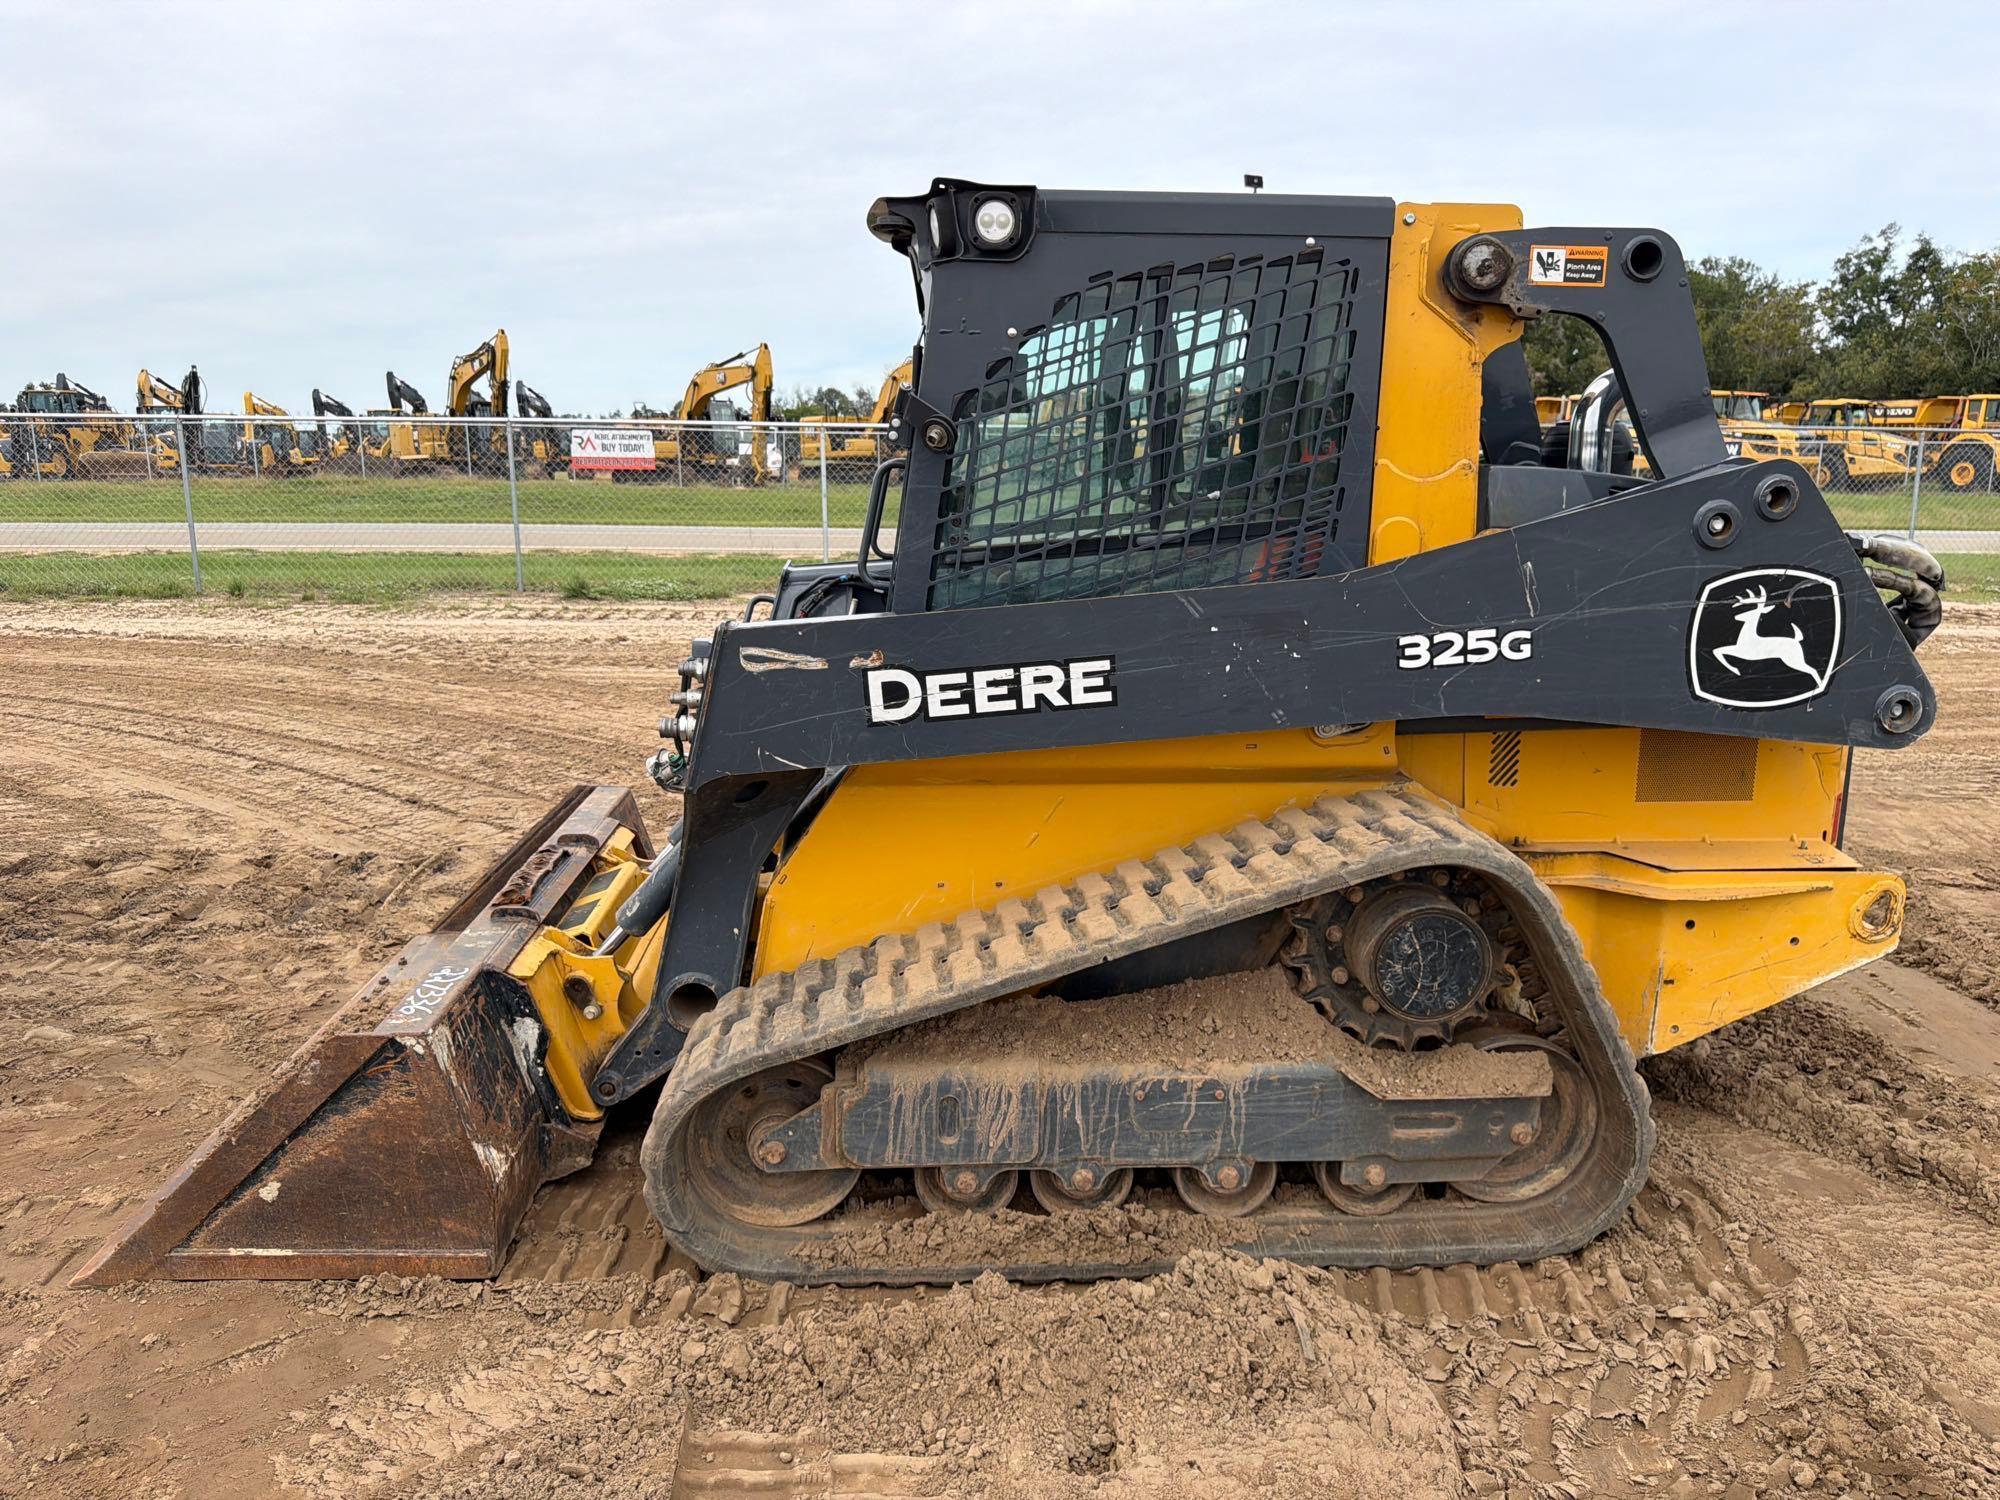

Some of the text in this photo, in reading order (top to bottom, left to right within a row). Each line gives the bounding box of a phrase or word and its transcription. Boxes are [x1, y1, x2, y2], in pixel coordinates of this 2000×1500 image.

[601, 443, 645, 453] BUY TODAY!
[1399, 628, 1531, 669] 325G
[867, 659, 1112, 723] DEERE
